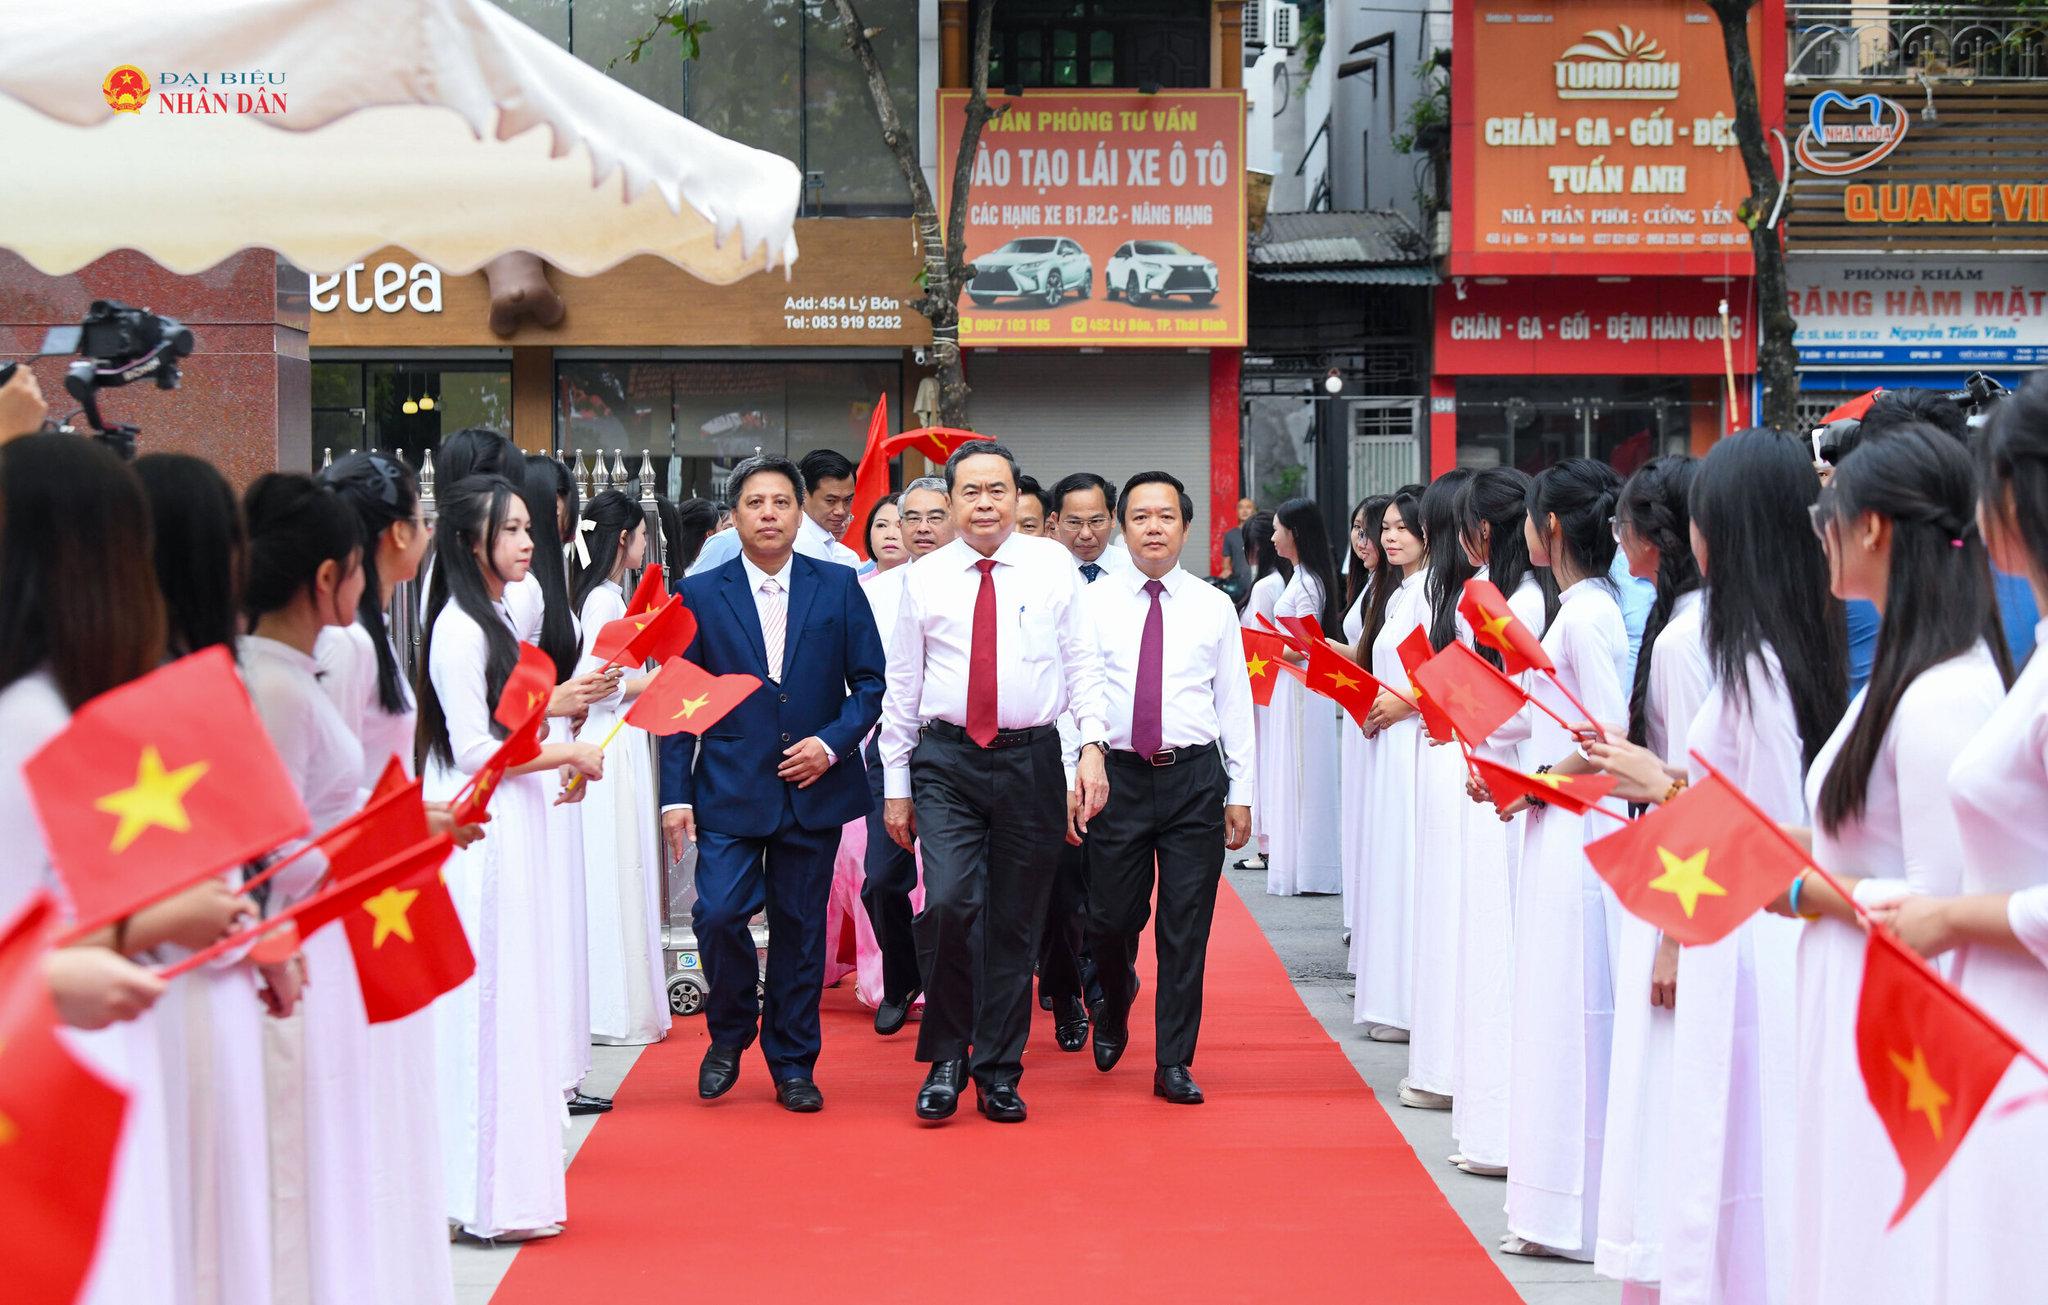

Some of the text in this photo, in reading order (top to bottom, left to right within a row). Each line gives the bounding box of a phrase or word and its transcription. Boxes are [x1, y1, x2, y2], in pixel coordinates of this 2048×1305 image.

[1038, 106, 1114, 132] PHÒNG
[1119, 110, 1149, 132] TƯ
[1152, 104, 1198, 132] VẤN
[1485, 112, 1557, 146] CHĂN
[1575, 118, 1611, 146] GA
[1629, 106, 1674, 146] GỐI
[1824, 125, 1892, 142] NHA KHOA
[969, 140, 1228, 195] ÀO TẠO LÁI XE Ô TÔ
[1630, 165, 1687, 194] ANH
[971, 202, 998, 225] CÁC
[1002, 205, 1041, 229] HẠNG
[1044, 205, 1062, 225] XE
[1065, 204, 1118, 225] B1.B2.C
[1132, 202, 1171, 225] NÂNG
[1174, 205, 1213, 229] HẠNG
[1501, 204, 1536, 225] NHÀ
[1541, 204, 1586, 225] PHÂN
[1844, 183, 2048, 222] QUANG VI
[1844, 267, 1984, 281] PHÒNG KHÁM
[820, 296, 846, 310] 454
[849, 296, 867, 313] Lý
[1885, 285, 1962, 316] HÀM
[1975, 285, 2048, 322] MẶT
[811, 315, 838, 329] 083
[841, 315, 865, 329] 919
[867, 315, 902, 329] 8282
[1450, 313, 1501, 340] CHĂN
[1517, 316, 1543, 340] GA
[1559, 310, 1590, 340] GỐI
[1606, 313, 1647, 343] ĐỆM
[1651, 313, 1690, 340] HÀN
